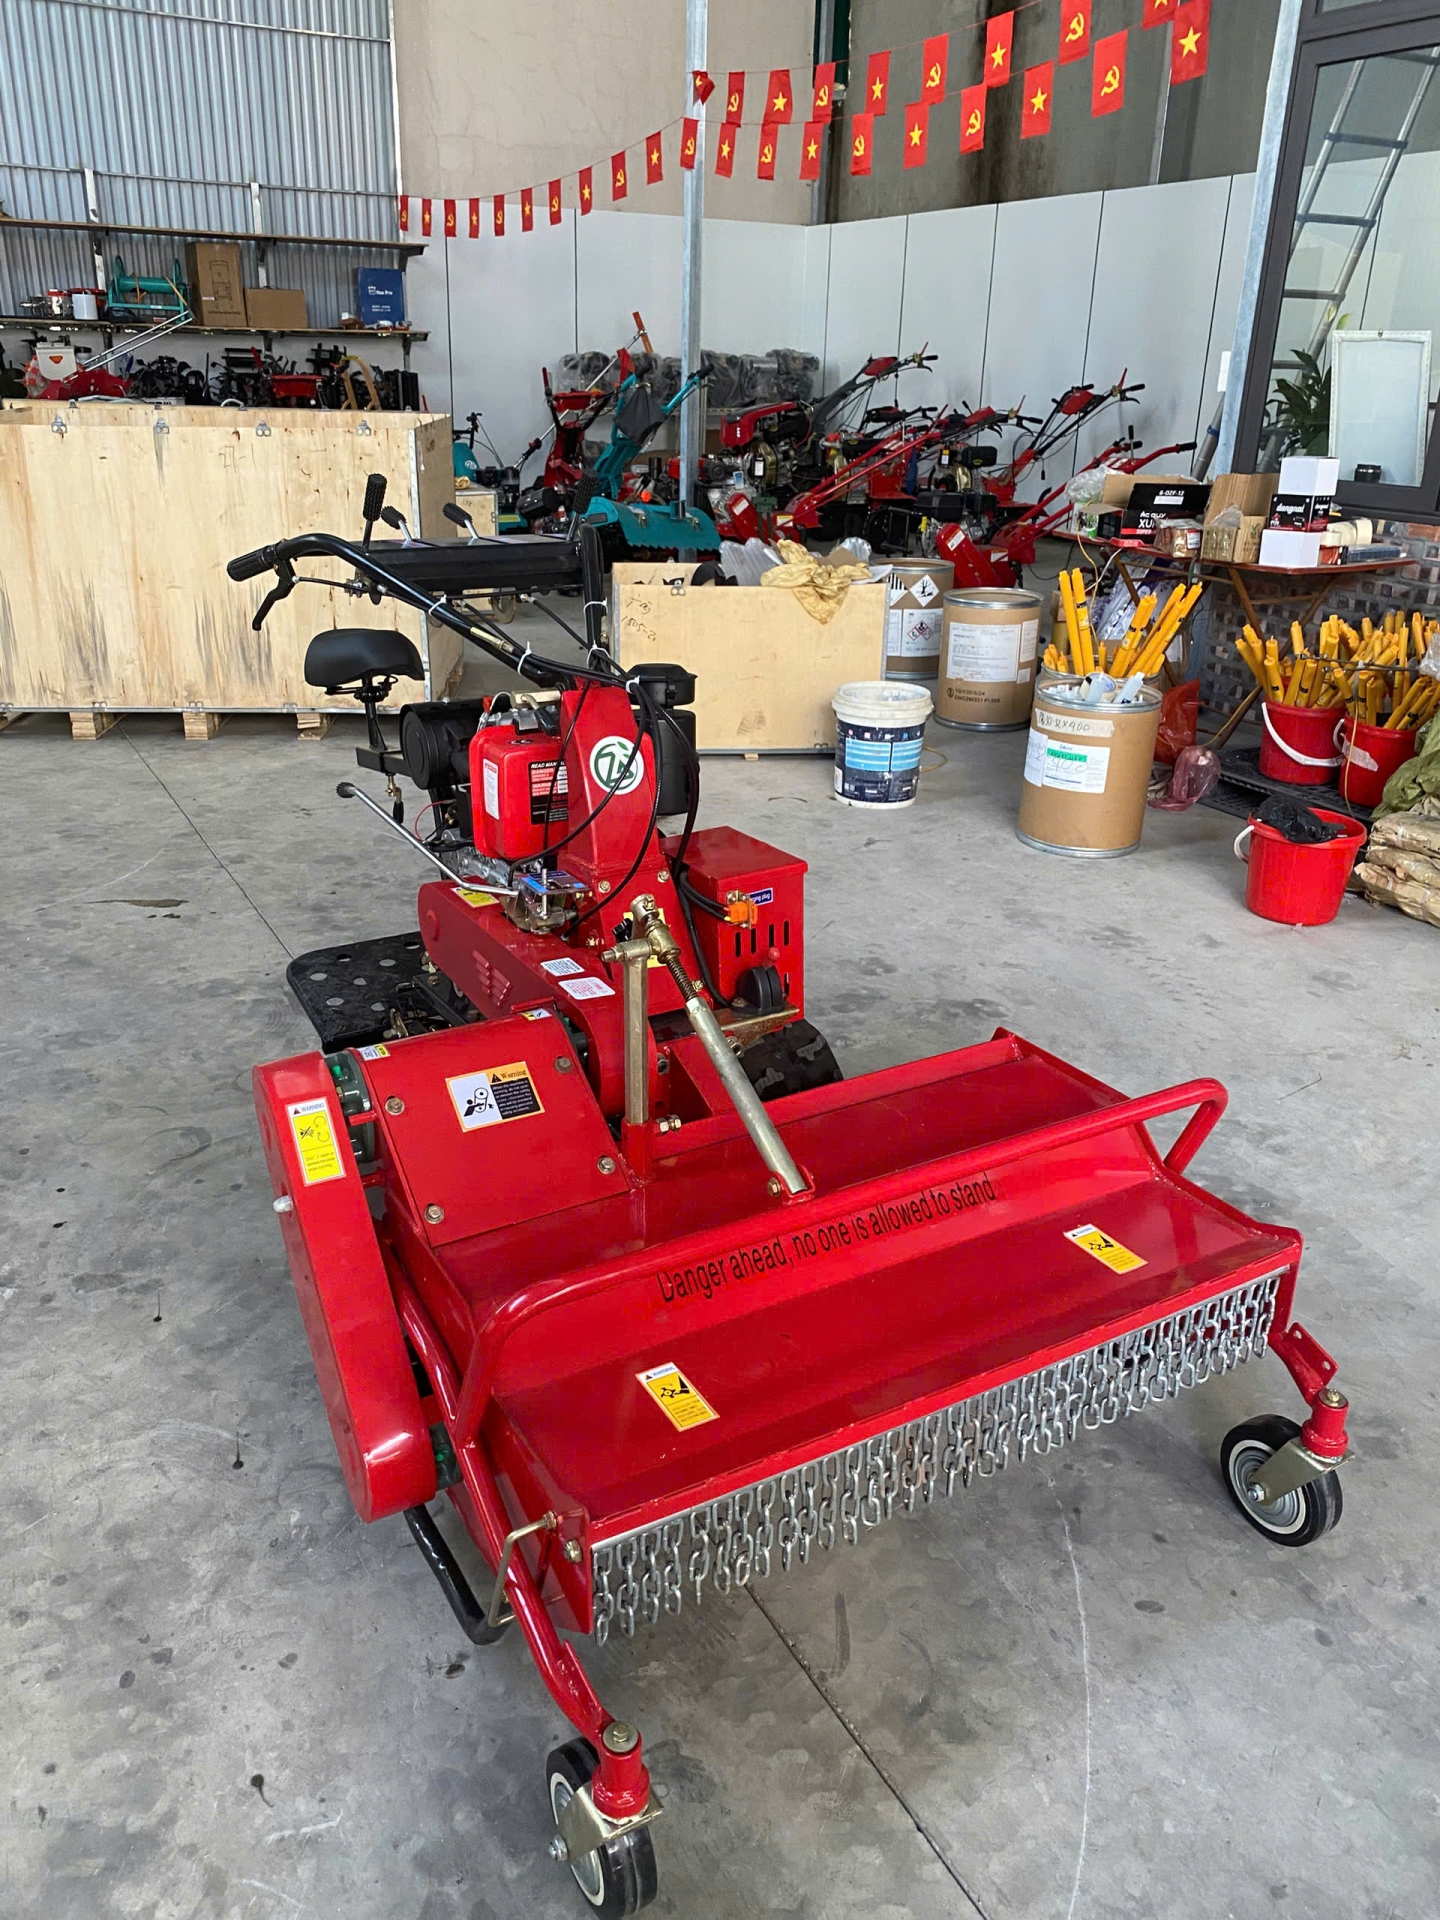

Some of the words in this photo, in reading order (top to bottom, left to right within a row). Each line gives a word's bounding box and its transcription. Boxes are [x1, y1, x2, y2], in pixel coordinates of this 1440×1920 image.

[500, 1070, 527, 1079] Warning
[301, 1103, 325, 1112] WARNING
[656, 1258, 728, 1302] Danger
[729, 1236, 795, 1280] ahead,
[792, 1231, 817, 1260] no
[818, 1222, 851, 1251] one
[851, 1216, 869, 1242] is
[869, 1190, 933, 1236] allowed
[930, 1189, 950, 1216] to
[950, 1172, 996, 1210] stand
